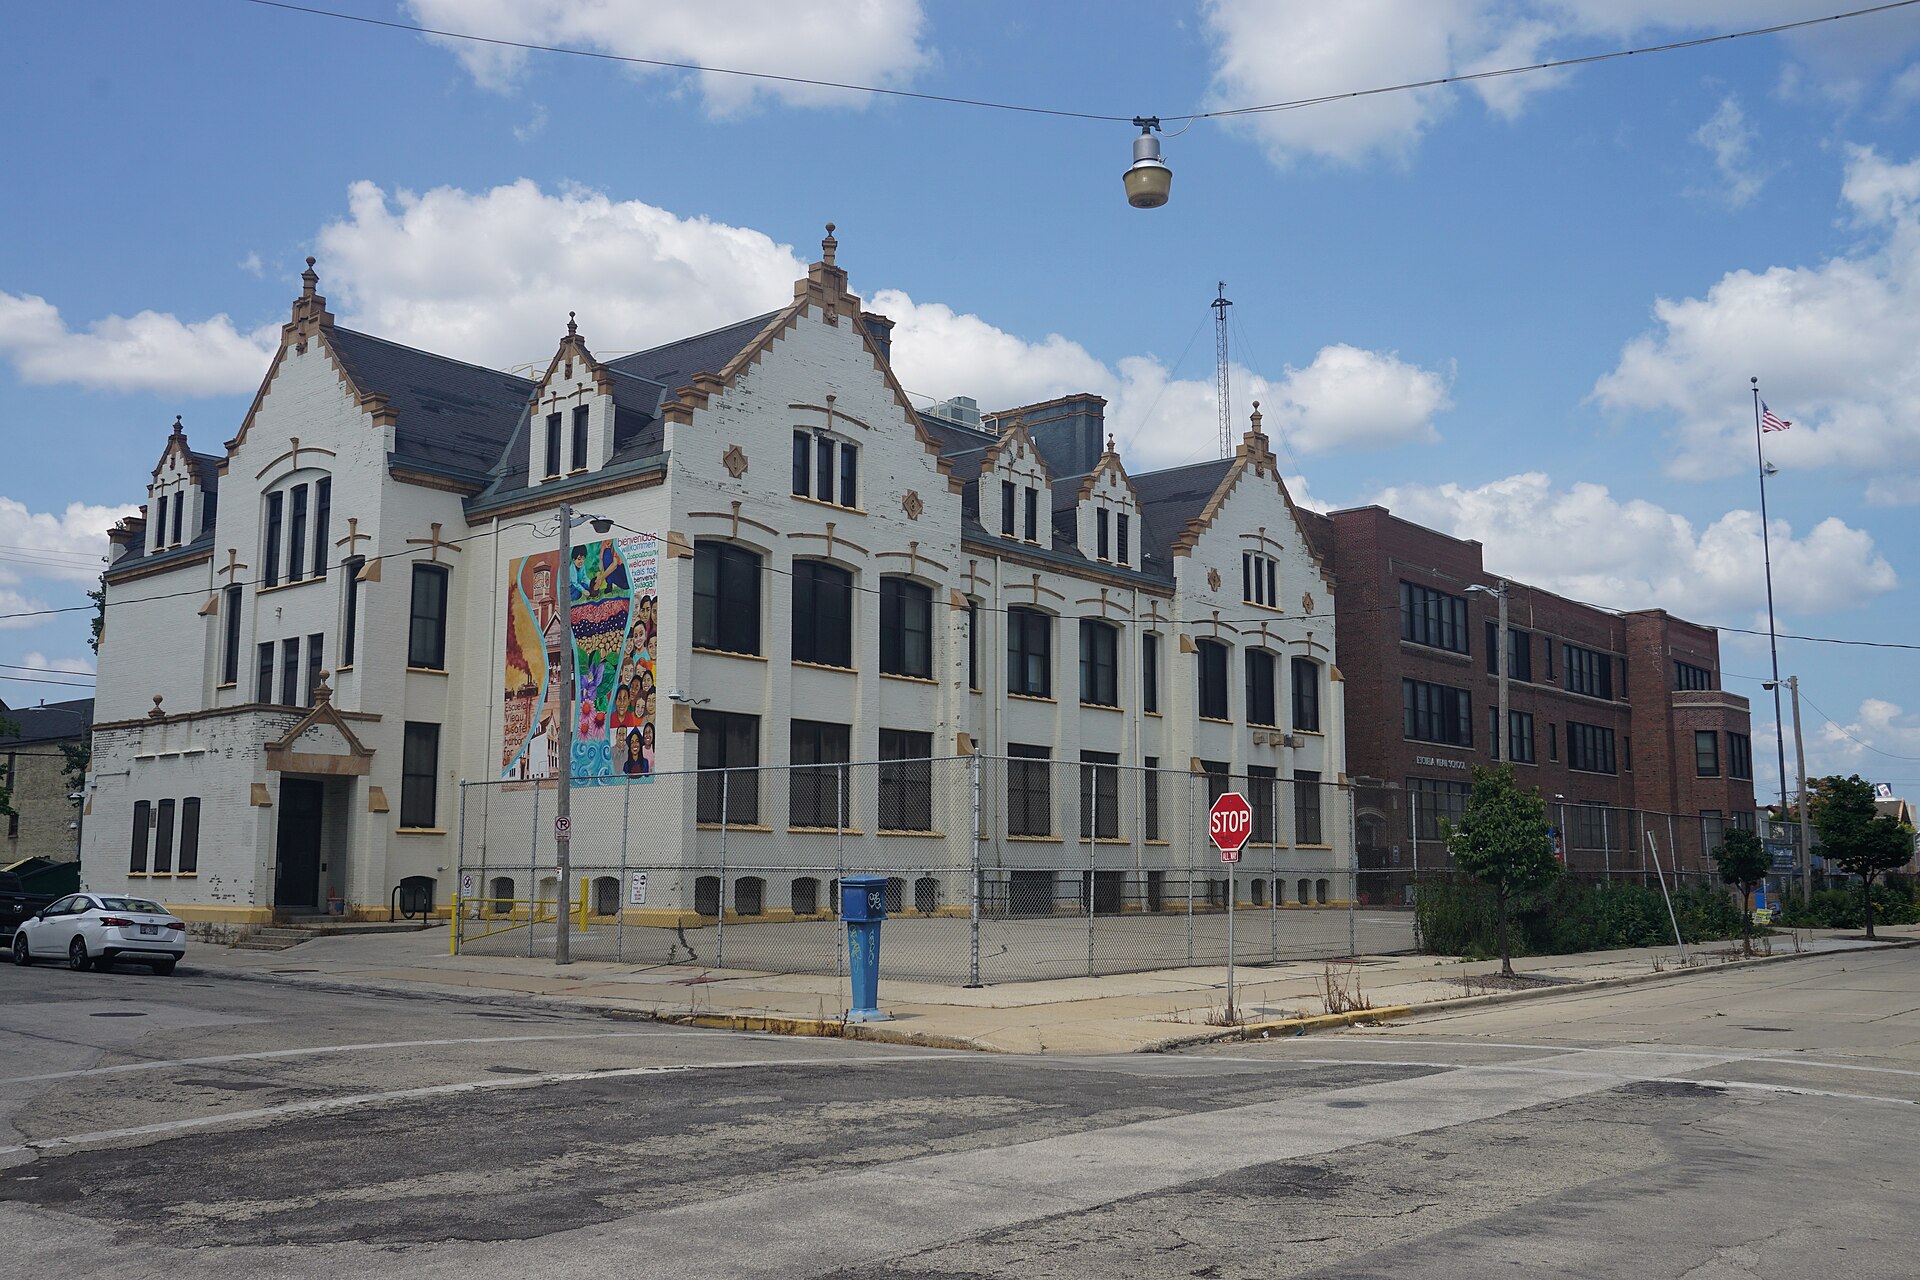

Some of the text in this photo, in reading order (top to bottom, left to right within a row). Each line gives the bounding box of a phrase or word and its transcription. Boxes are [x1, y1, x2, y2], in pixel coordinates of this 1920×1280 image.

[618, 532, 657, 547] bienvenidos
[629, 558, 656, 568] welcome
[505, 702, 526, 712] Escuela
[505, 714, 524, 722] Vieau
[511, 723, 526, 734] safe
[505, 737, 524, 746] harbor
[504, 746, 513, 757] for
[1448, 760, 1466, 769] SCHOOL
[1212, 810, 1249, 833] STOP
